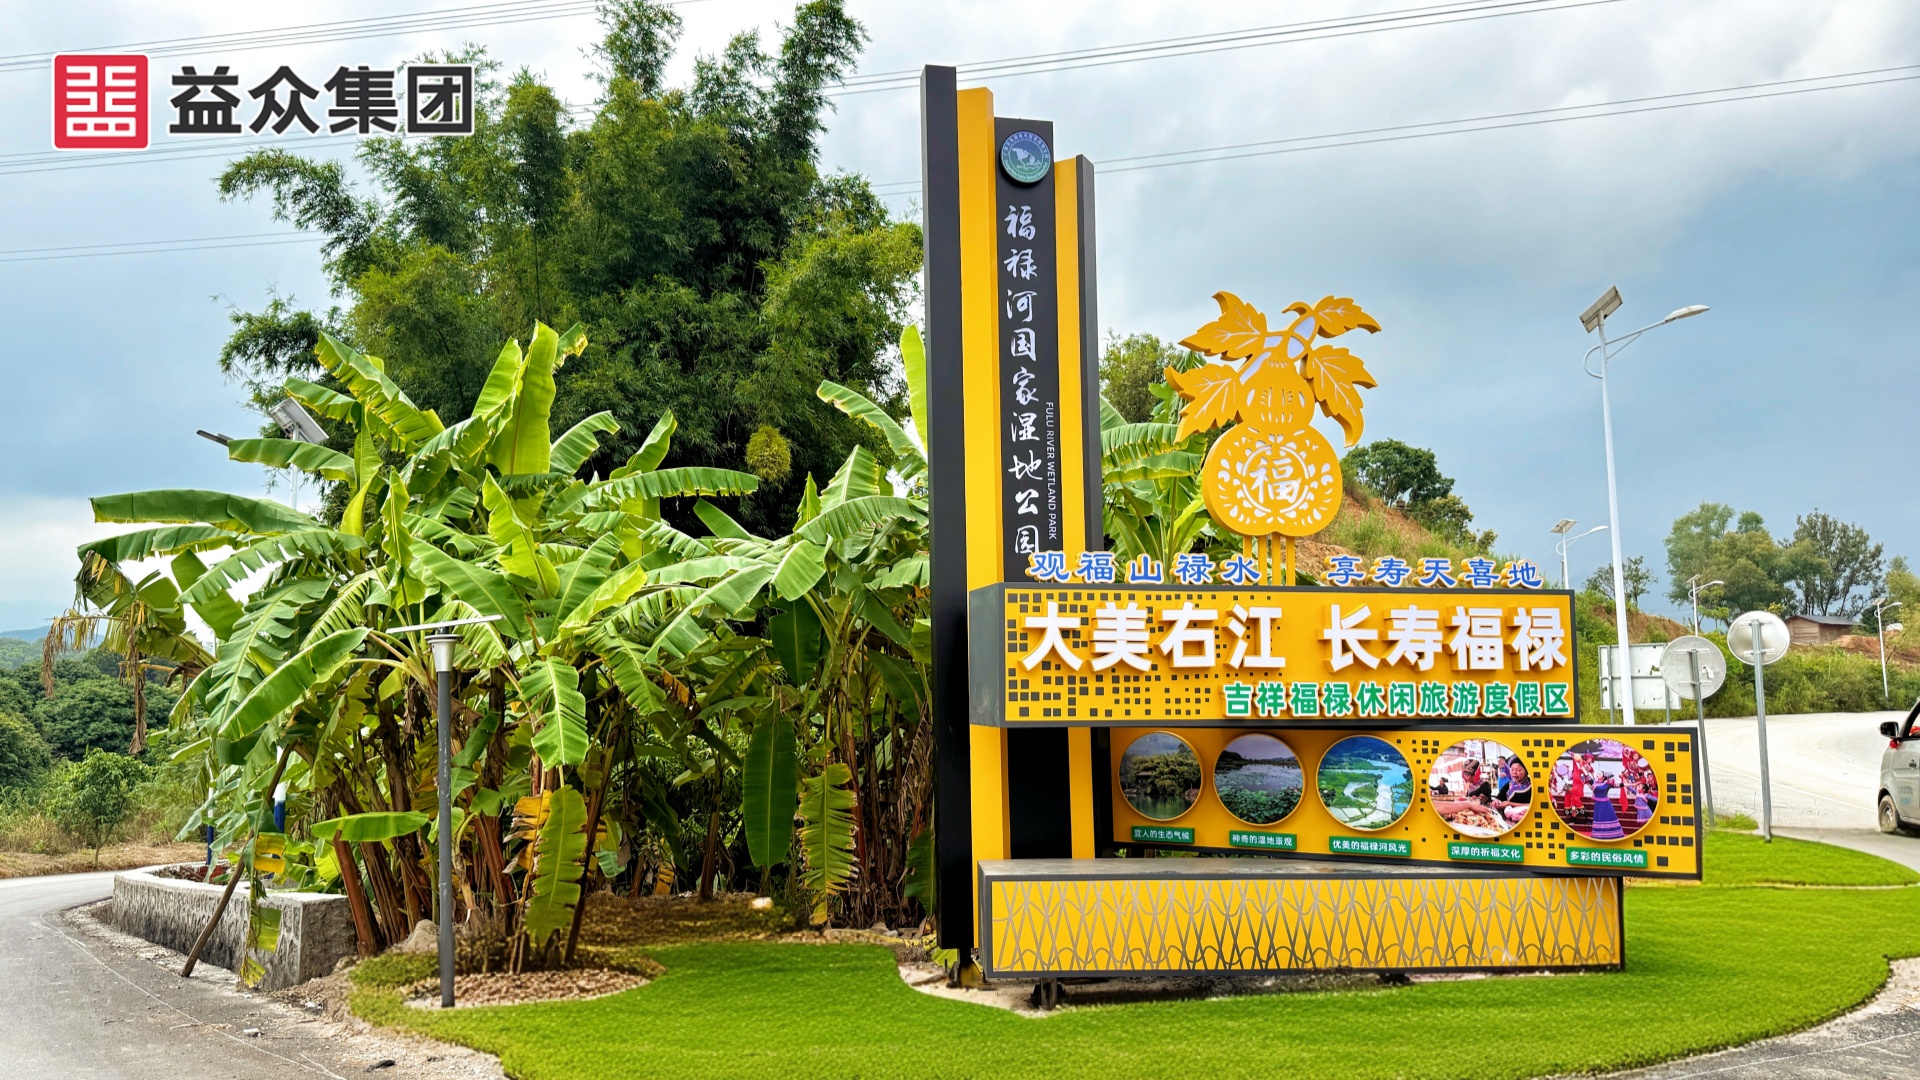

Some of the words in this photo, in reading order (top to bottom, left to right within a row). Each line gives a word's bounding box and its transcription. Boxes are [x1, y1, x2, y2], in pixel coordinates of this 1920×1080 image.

[1003, 204, 1043, 554] 福禄河国家湿地公园
[1045, 401, 1054, 428] FULU
[1046, 430, 1055, 459] RIVER
[1047, 461, 1057, 511] WETLAND
[1249, 456, 1302, 504] 福
[1048, 513, 1057, 540] PARK
[1029, 551, 1262, 585] 观福山禄水
[1326, 554, 1544, 589] 享寿天喜地
[1021, 601, 1286, 673] 大美右江
[1322, 603, 1569, 673] 长寿福禄
[1223, 681, 1571, 717] 吉祥福禄休闲旅游度假区
[1134, 829, 1190, 840] 宜人的生态气候
[1231, 833, 1293, 846] 神奇的湿地景观
[1332, 839, 1407, 853] 优美的福禄河风光
[1450, 846, 1521, 859] 深厚的祈福文化
[1569, 850, 1644, 864] 多彩的民俗风情
